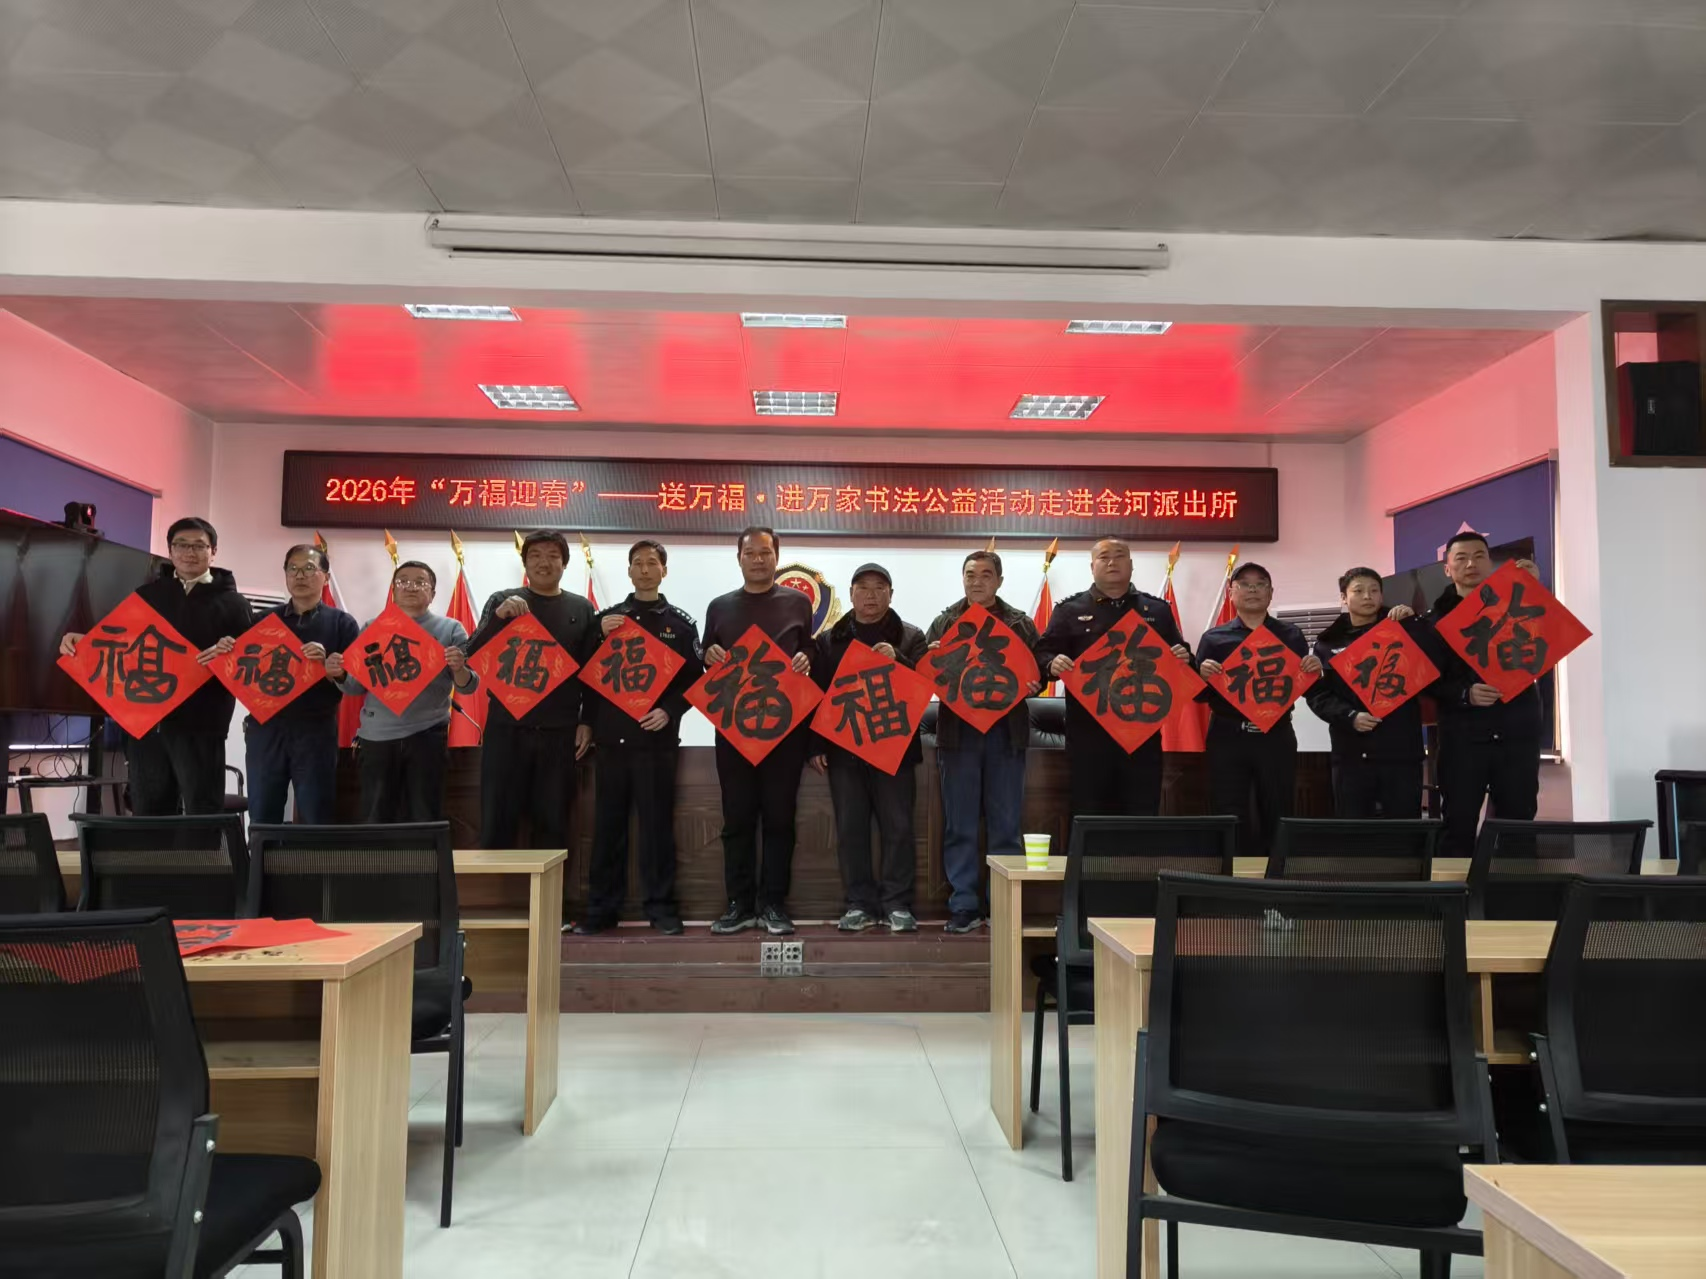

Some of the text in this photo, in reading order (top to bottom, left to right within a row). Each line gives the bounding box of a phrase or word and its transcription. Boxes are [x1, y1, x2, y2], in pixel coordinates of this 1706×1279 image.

[89, 624, 188, 703] 福
[234, 643, 302, 697] 福
[365, 634, 421, 688] 福
[496, 636, 557, 694] 福
[600, 636, 657, 693] 福
[704, 641, 793, 741] 福
[930, 616, 1019, 711] 福
[1080, 624, 1172, 723] 福
[1226, 643, 1293, 708] 福
[1352, 641, 1407, 705] 福
[832, 663, 911, 746] 福
